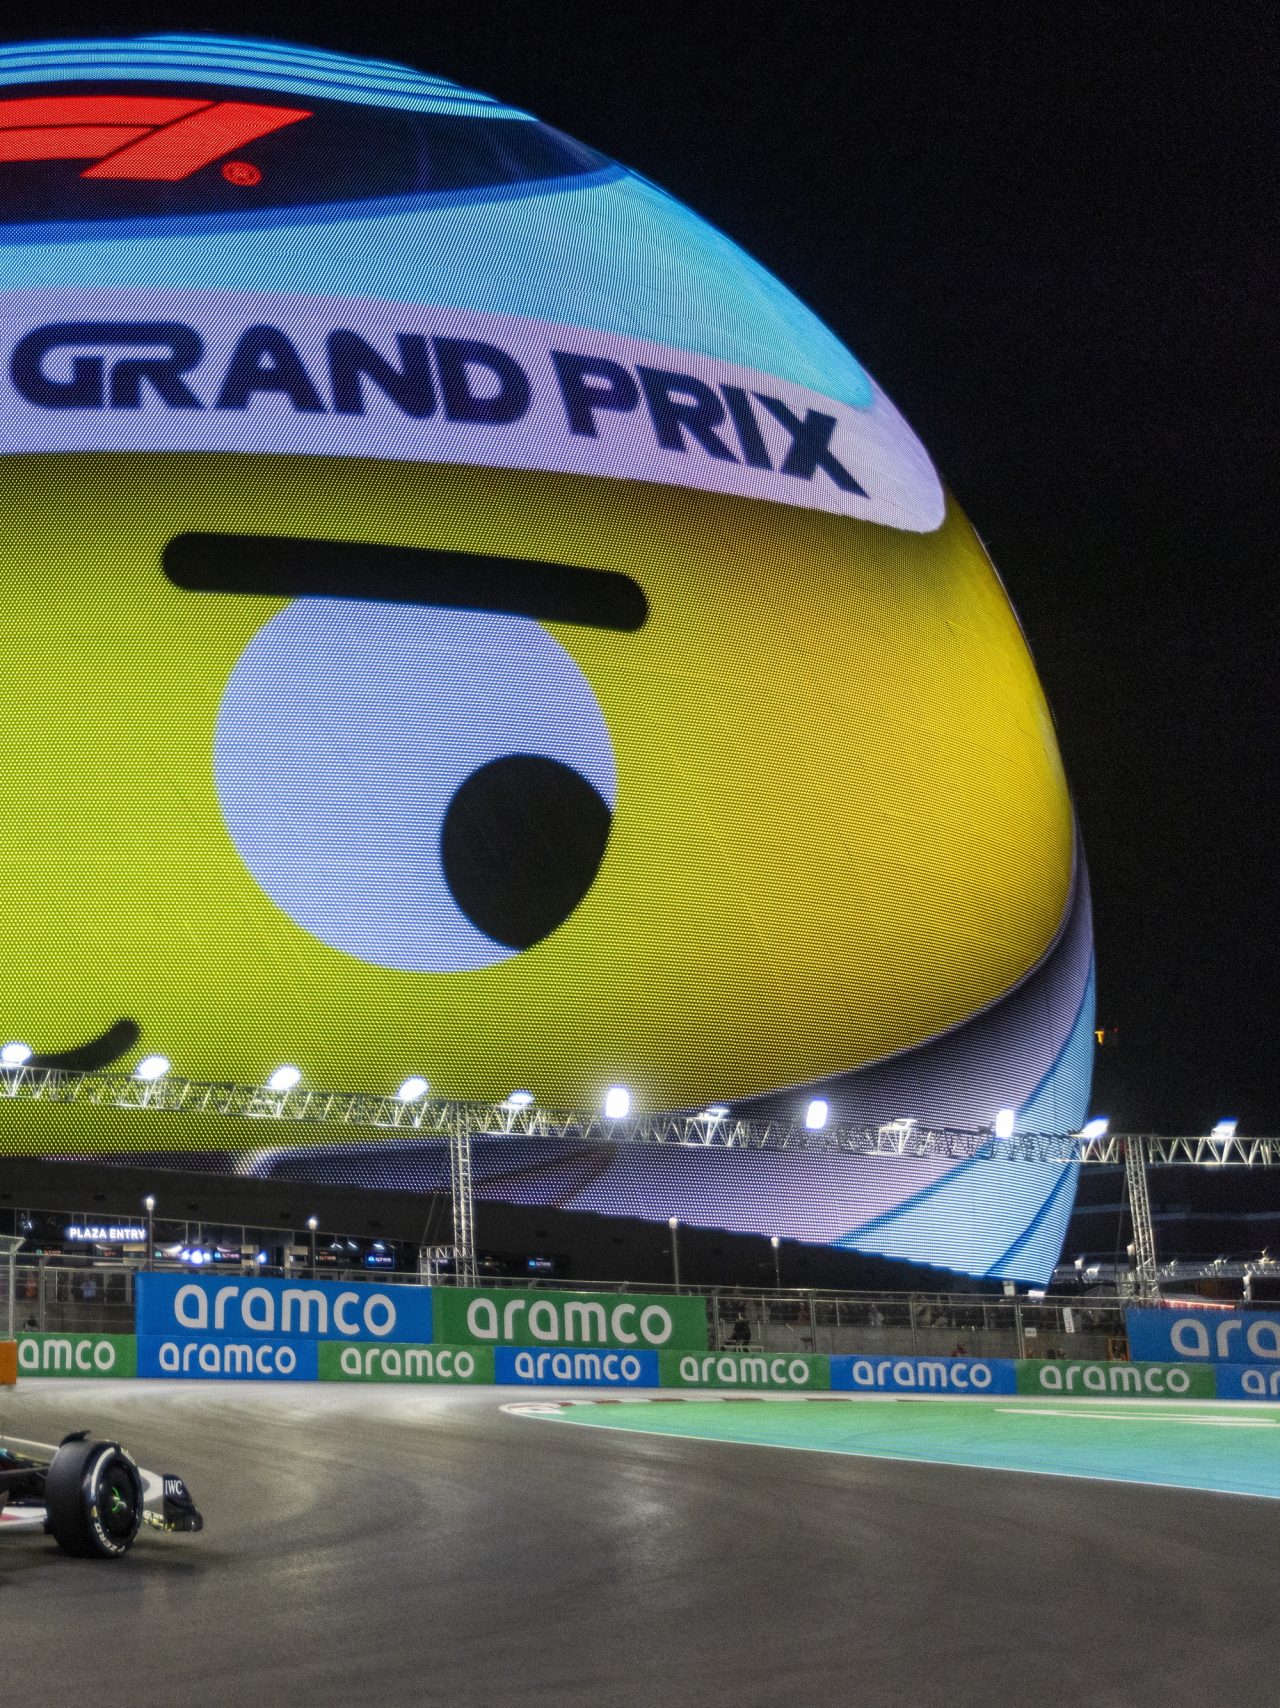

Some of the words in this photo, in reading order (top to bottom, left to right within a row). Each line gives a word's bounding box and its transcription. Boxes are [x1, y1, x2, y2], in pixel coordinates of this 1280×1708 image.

[10, 320, 529, 425] GRAND
[552, 350, 870, 498] PRIX
[70, 1228, 107, 1239] PLAZA
[110, 1229, 145, 1239] ENTRY
[174, 1284, 397, 1336] aramco
[467, 1298, 672, 1344] aramco
[1180, 1318, 1280, 1358] ara
[159, 1342, 297, 1374] aramco
[341, 1347, 475, 1378] aramco
[515, 1352, 641, 1381] aramco
[680, 1356, 810, 1384] aramco
[852, 1359, 992, 1388] aramco
[1039, 1365, 1191, 1393] aramco
[165, 1480, 183, 1494] IWC
